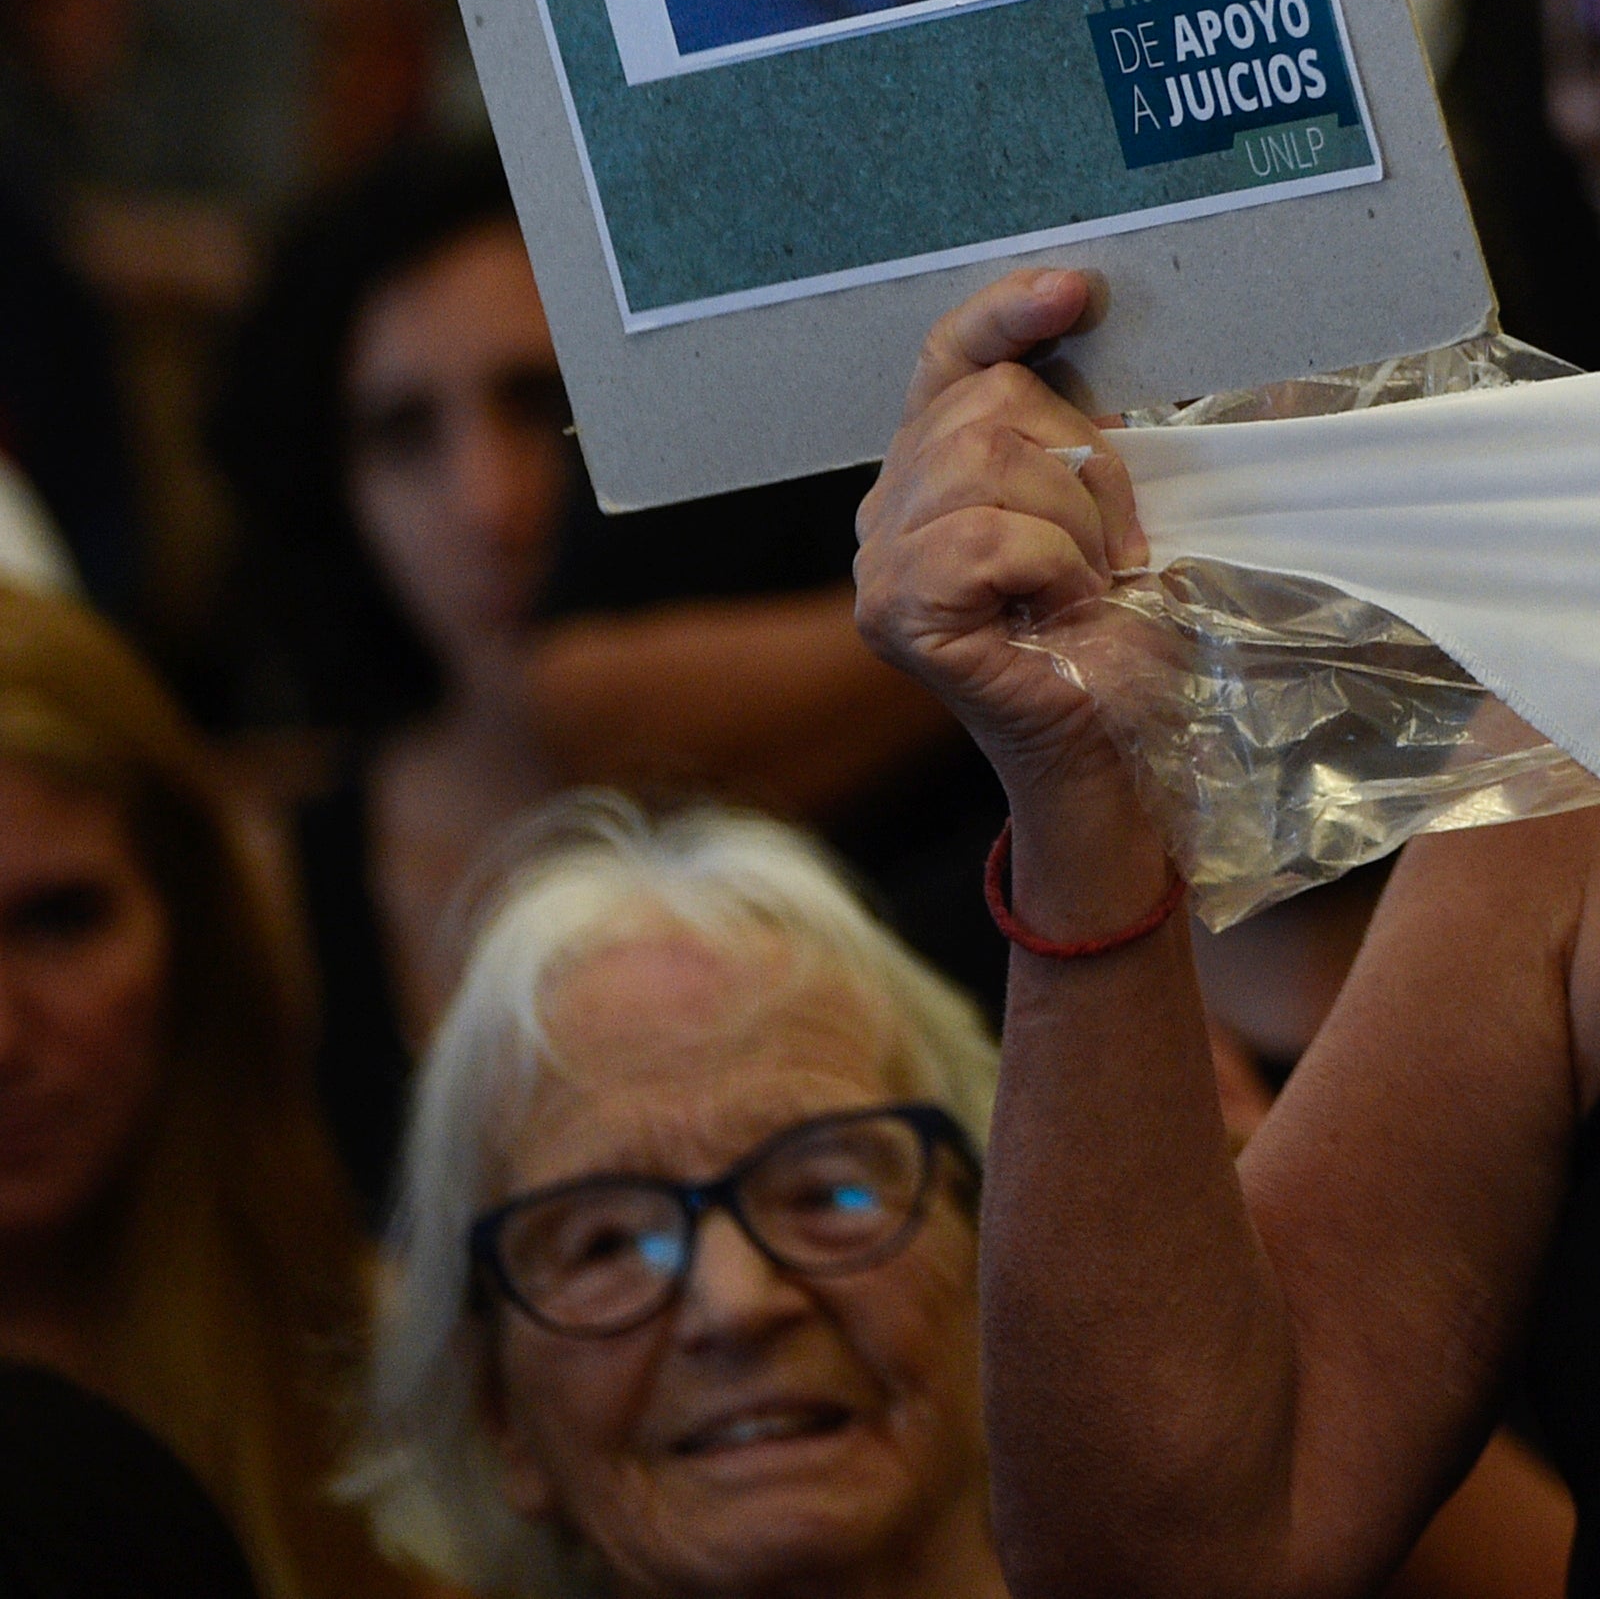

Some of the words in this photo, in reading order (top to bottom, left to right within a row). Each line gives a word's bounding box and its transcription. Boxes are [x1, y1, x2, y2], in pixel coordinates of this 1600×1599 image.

[1110, 21, 1166, 75] DE
[1133, 84, 1162, 135] A
[1164, 47, 1327, 129] JUICIOS
[1245, 125, 1325, 178] UNLP
